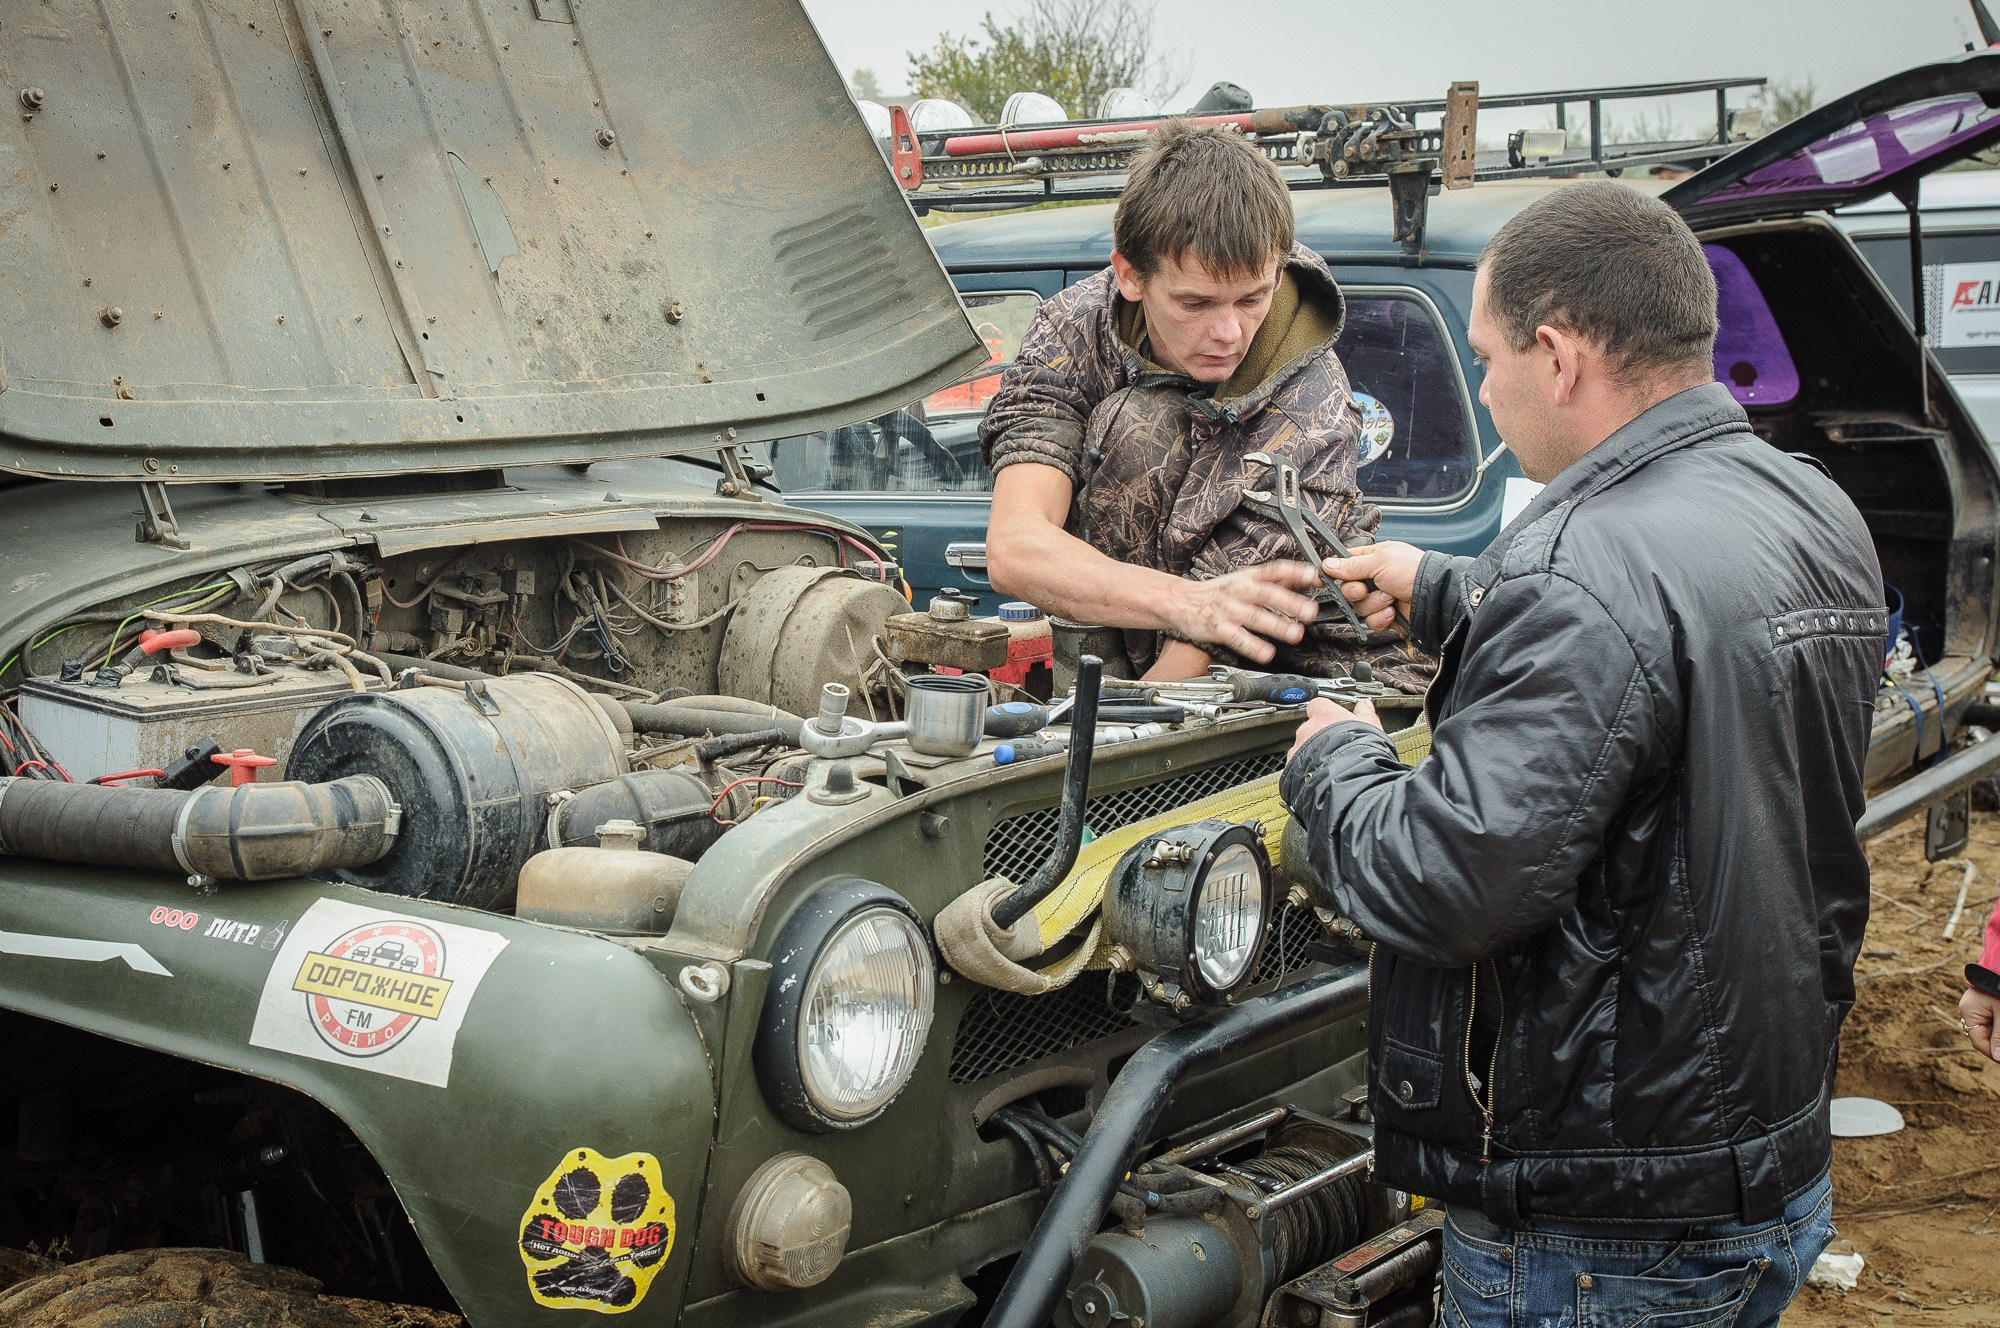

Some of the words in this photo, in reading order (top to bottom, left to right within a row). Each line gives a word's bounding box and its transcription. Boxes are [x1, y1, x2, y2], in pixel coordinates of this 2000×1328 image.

[204, 918, 261, 945] ЛИТР
[320, 1012, 394, 1047] РАДИО
[346, 1008, 373, 1029] FM
[540, 1219, 616, 1249] TOUGH
[619, 1225, 662, 1248] DOG
